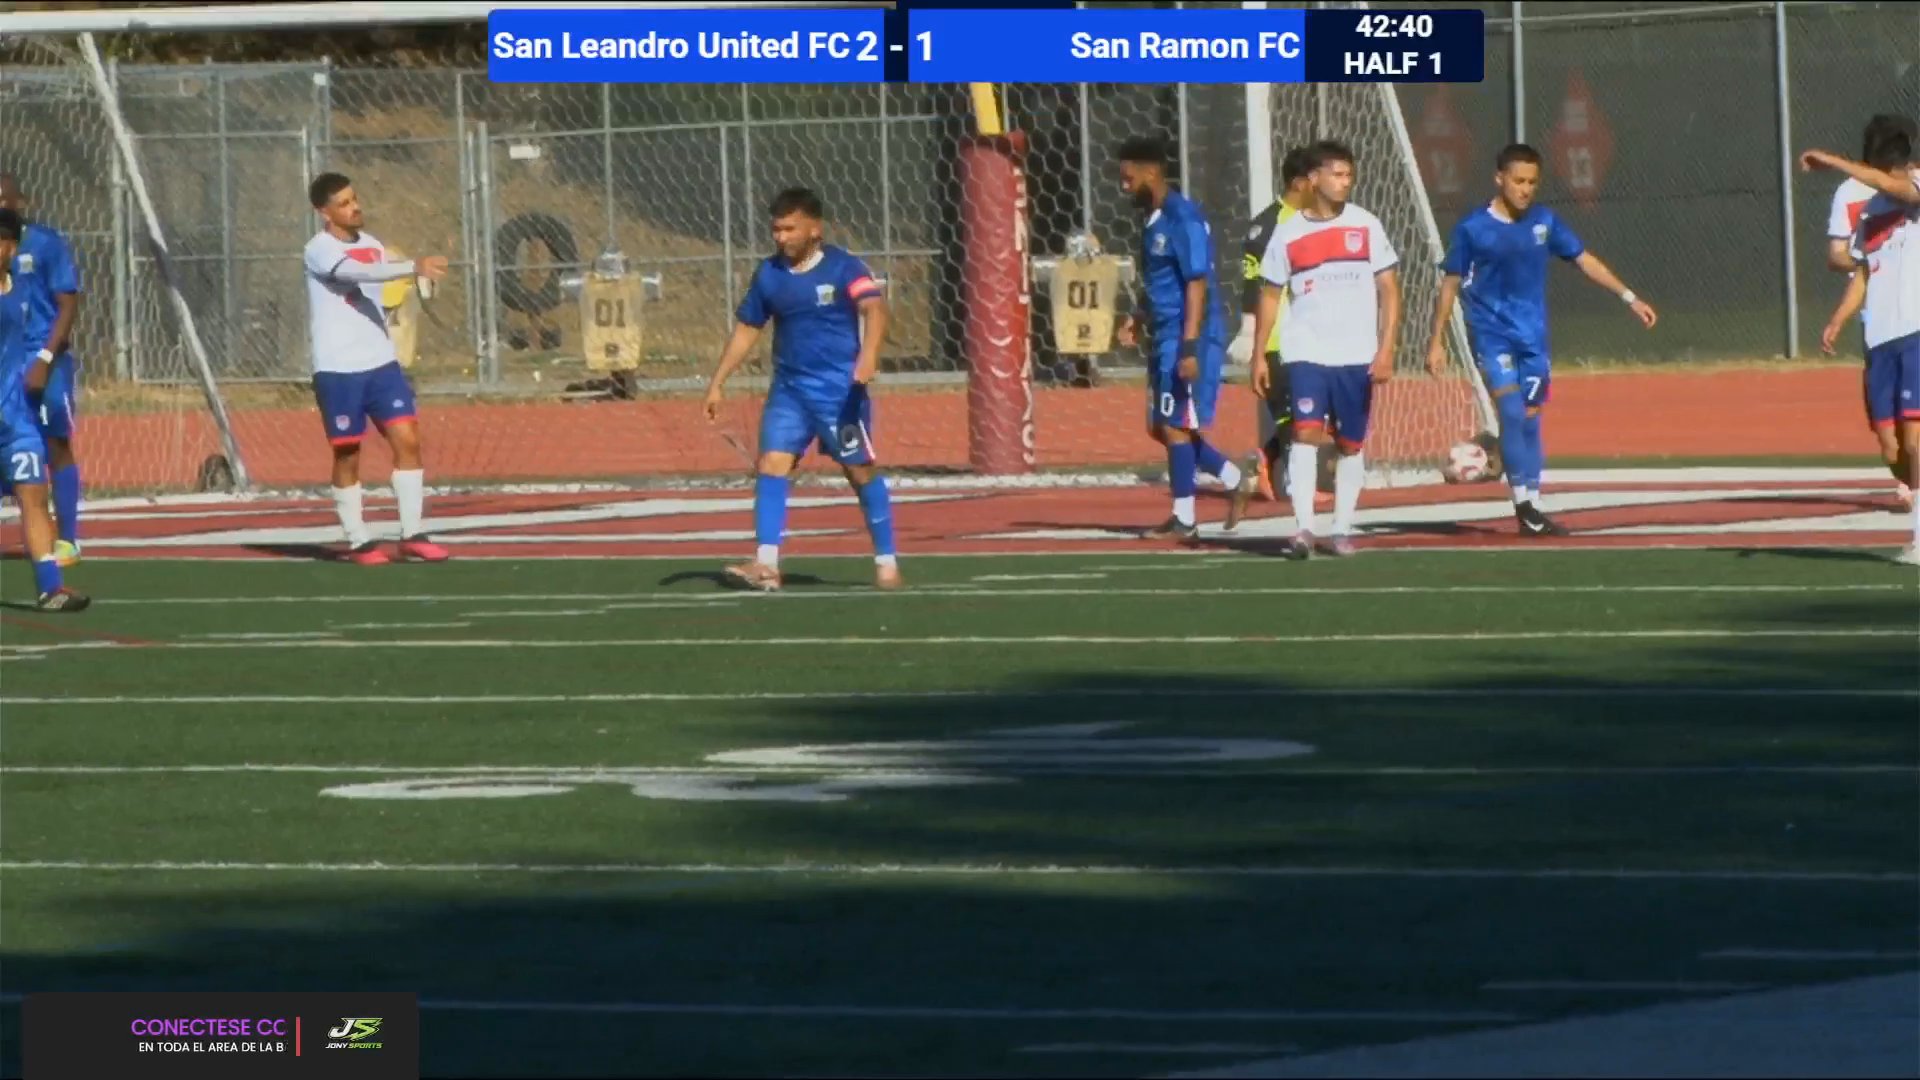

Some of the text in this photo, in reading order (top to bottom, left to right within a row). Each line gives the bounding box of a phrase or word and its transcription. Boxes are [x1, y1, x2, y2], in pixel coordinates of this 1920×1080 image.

[1068, 281, 1098, 309] 01
[595, 298, 626, 328] 01
[1525, 375, 1541, 401] 7
[11, 451, 40, 480] 21
